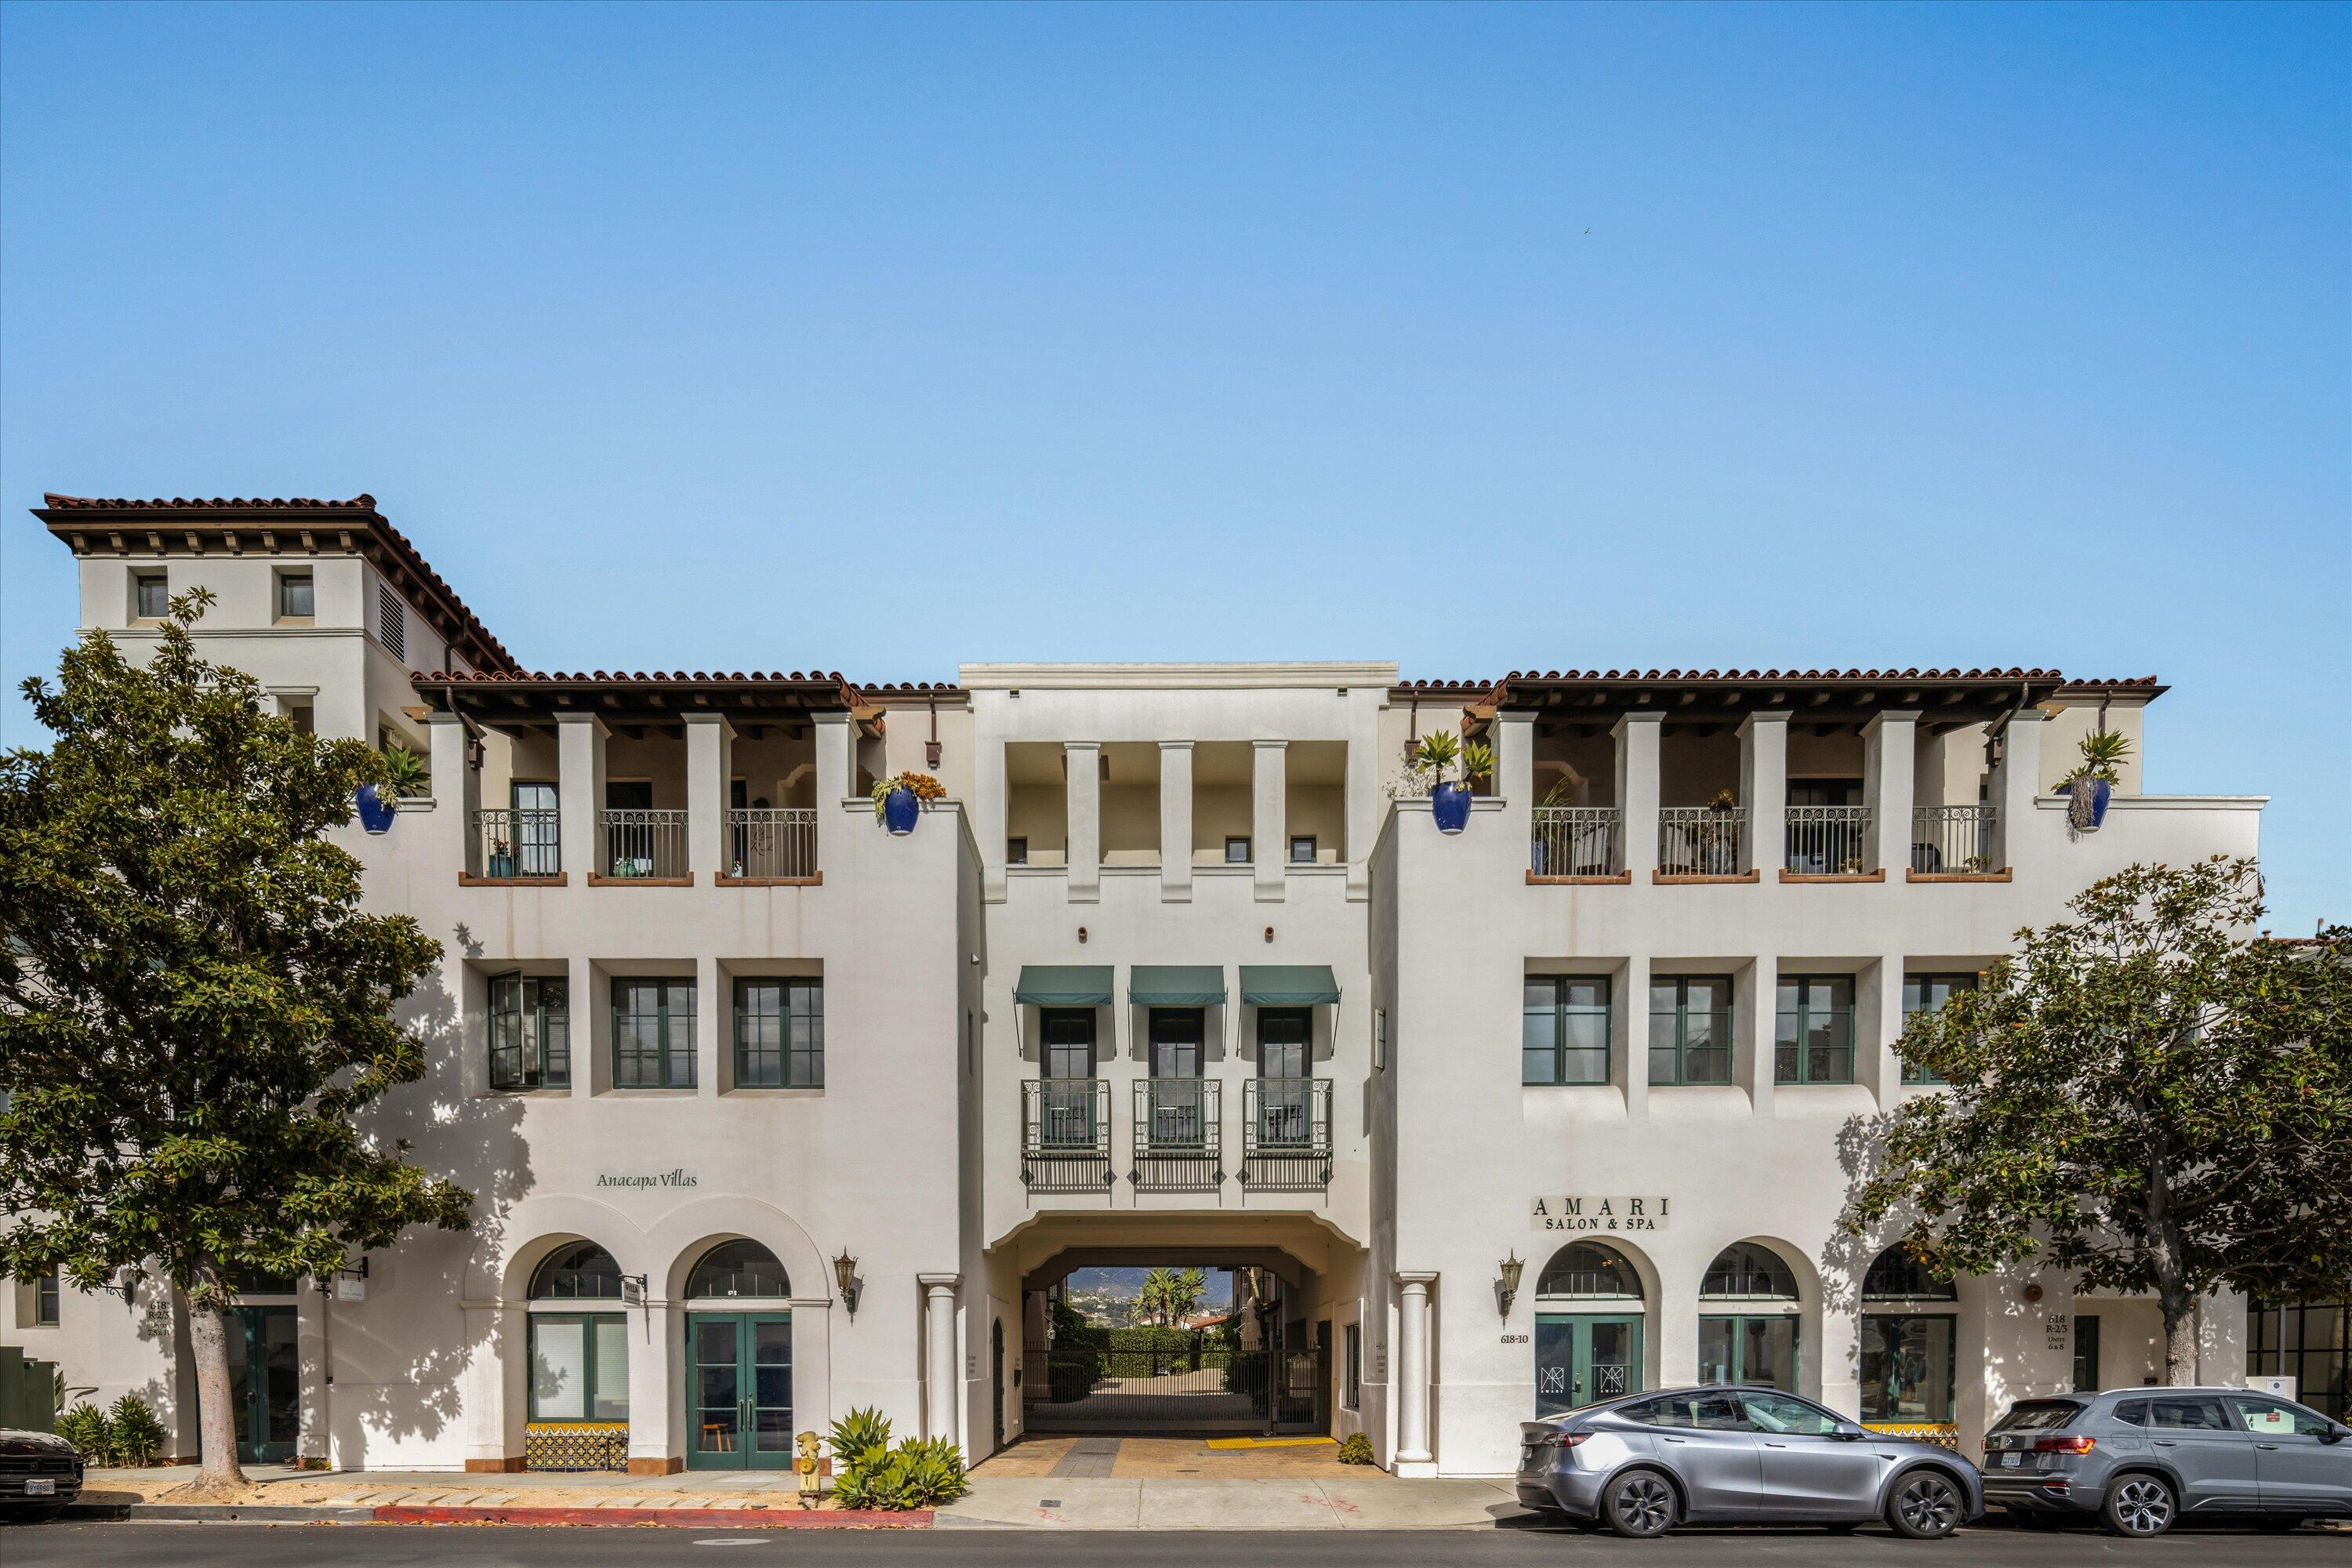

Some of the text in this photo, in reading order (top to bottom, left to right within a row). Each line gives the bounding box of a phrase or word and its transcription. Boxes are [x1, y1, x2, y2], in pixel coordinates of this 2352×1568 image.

[597, 1169, 697, 1191] Anacapa Villas
[1534, 1198, 1668, 1215] AMARI
[1545, 1218, 1655, 1229] SALON & SPA
[150, 1301, 167, 1310] 618
[148, 1310, 170, 1320] R-2/3
[2049, 1315, 2065, 1323] 618
[2045, 1324, 2067, 1334] R-2/3
[1501, 1334, 1529, 1344] 618-10
